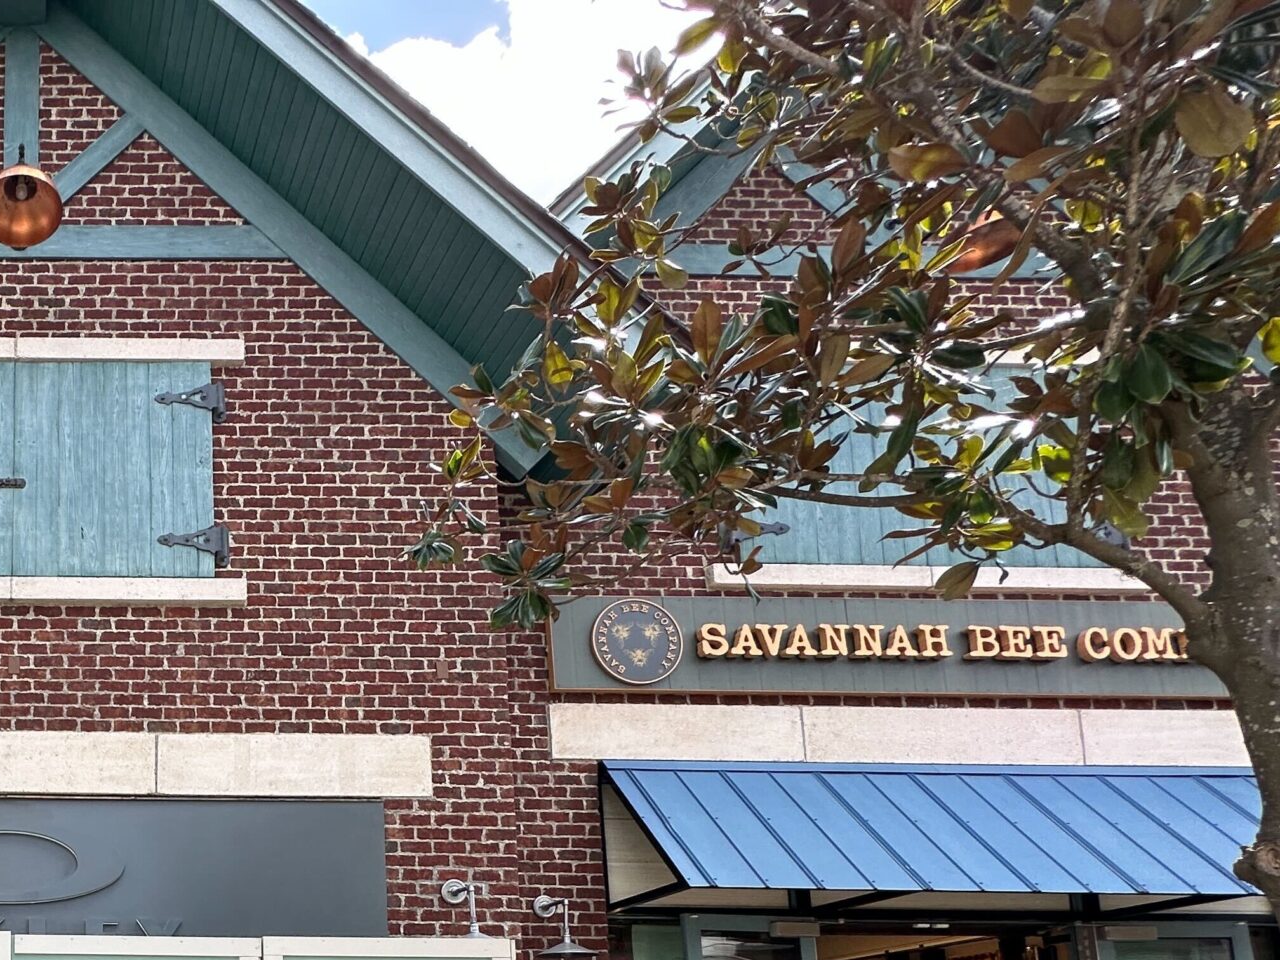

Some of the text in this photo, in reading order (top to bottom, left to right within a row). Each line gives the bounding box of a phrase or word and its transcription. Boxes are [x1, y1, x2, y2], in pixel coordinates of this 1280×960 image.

[598, 603, 678, 674] SAVANNAH BEE COMPANY
[698, 624, 951, 659] SAVANNAH
[965, 626, 1068, 660] BEE
